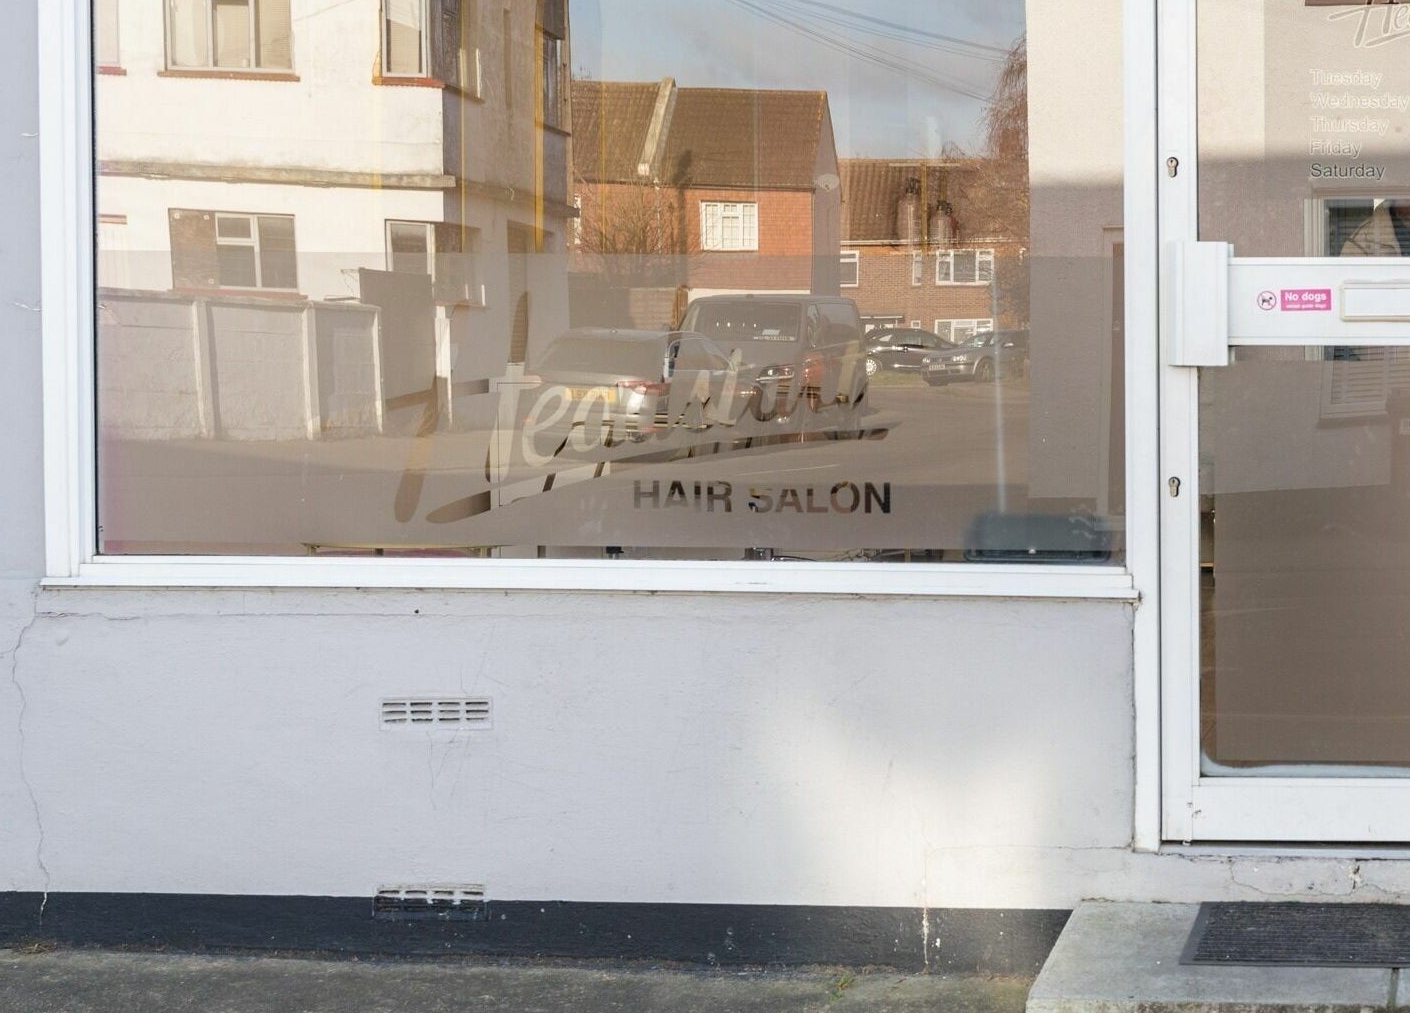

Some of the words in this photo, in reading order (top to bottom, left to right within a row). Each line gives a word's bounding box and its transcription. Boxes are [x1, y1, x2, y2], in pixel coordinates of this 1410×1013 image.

[1310, 69, 1383, 89] Tuesday
[1310, 92, 1410, 112] Wednesday
[1310, 116, 1389, 136] Thursday
[1310, 139, 1362, 159] Friday
[1310, 162, 1386, 181] Saturday
[1284, 291, 1299, 301] No
[1301, 291, 1327, 303] dogs
[632, 479, 733, 514] HAIR
[747, 480, 893, 515] SALON
